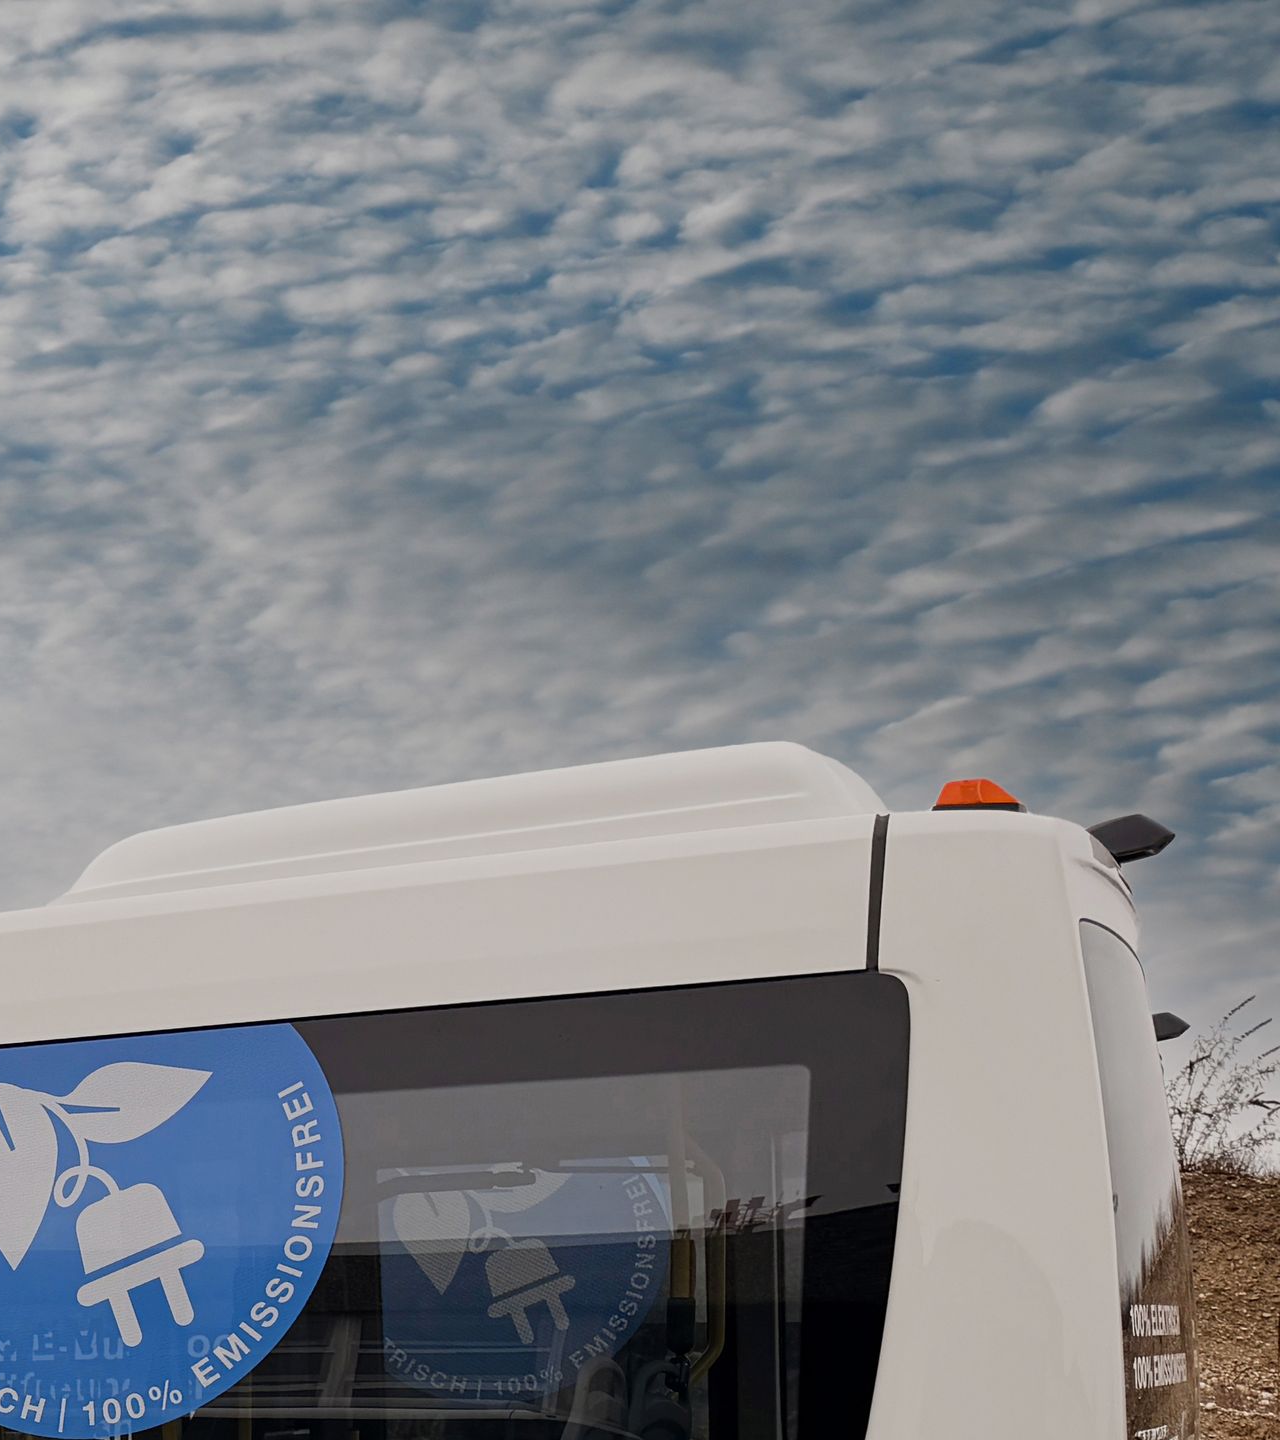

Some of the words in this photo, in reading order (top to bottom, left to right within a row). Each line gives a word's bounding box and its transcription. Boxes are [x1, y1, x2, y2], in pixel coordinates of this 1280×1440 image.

[82, 1380, 183, 1426] 100%
[190, 1081, 325, 1389] EMISSIONSFREI
[1130, 1304, 1151, 1337] 100%
[1133, 1356, 1153, 1390] 100%
